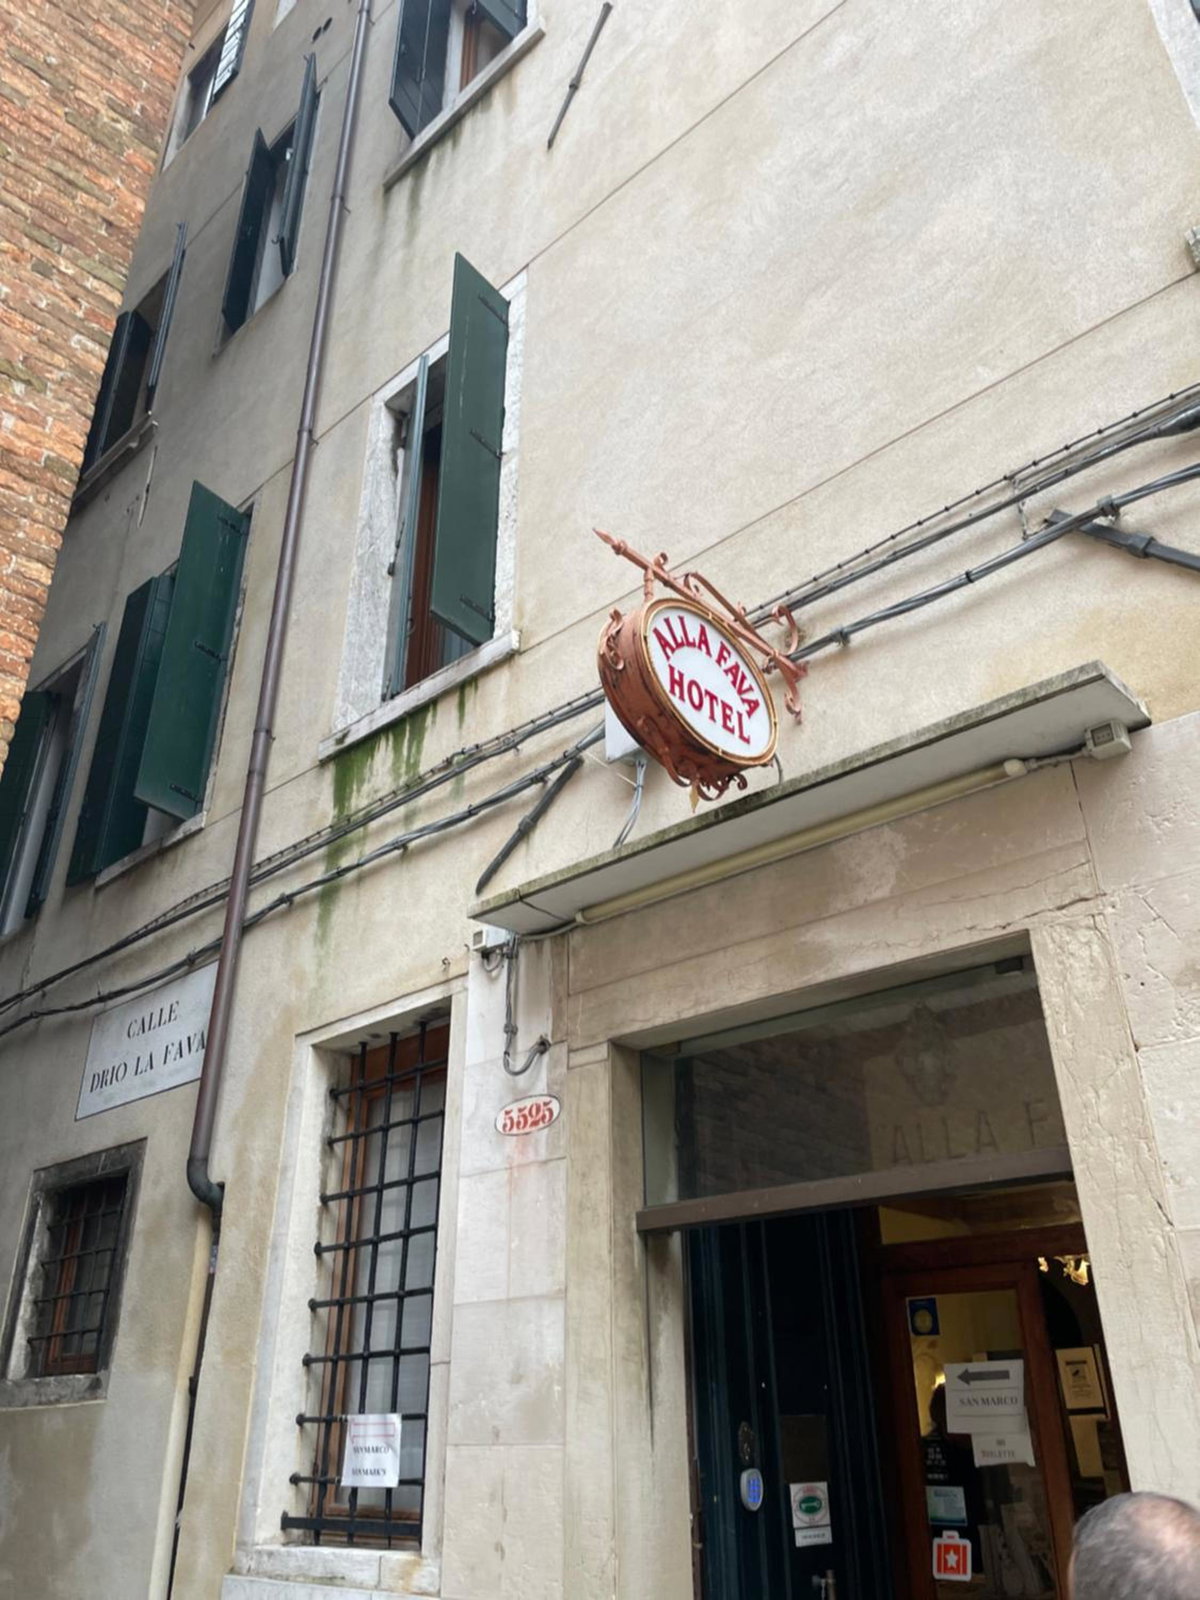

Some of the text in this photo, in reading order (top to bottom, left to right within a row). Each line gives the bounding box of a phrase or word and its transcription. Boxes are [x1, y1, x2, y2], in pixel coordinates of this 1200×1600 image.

[652, 615, 760, 719] ALLA FAVA
[668, 664, 750, 745] HOTEL
[127, 1000, 179, 1039] CALLE
[90, 1029, 206, 1093] DRIO LA FAVA
[502, 1100, 554, 1132] 5525
[959, 1396, 1018, 1407] SAN MARCO
